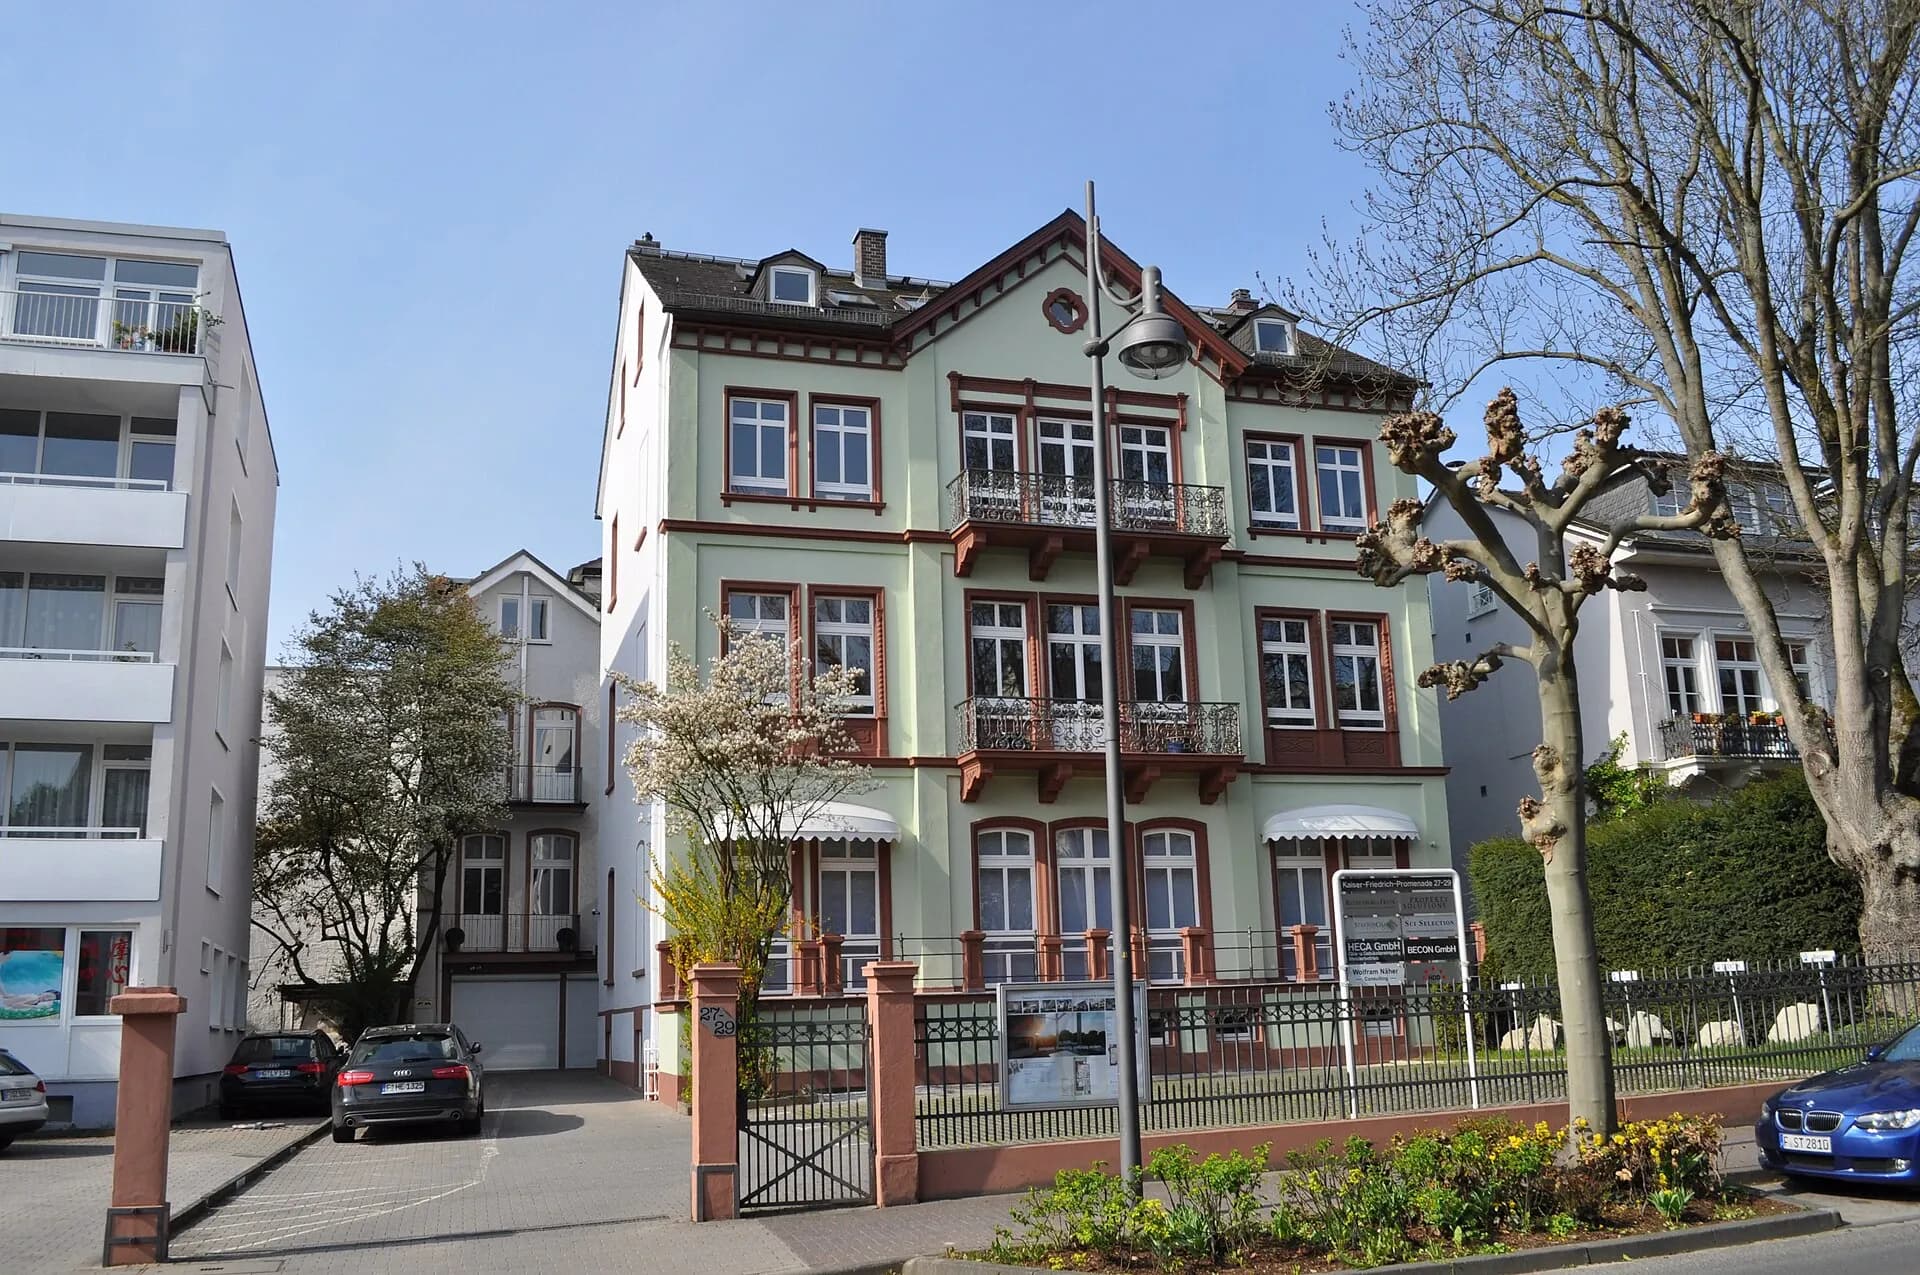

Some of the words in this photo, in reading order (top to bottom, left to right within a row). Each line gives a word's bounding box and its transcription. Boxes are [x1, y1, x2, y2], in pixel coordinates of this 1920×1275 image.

[1343, 880, 1433, 888] Kaiser-Friedrich-Promenade
[1434, 879, 1452, 887] 27-29
[1347, 942, 1372, 952] HECA
[1374, 941, 1400, 951] GmbH
[1407, 945, 1433, 954] BECON
[1435, 945, 1457, 953] GmbH
[1352, 968, 1379, 976] Wolfram
[1380, 967, 1398, 975] Näher
[701, 1008, 724, 1021] 27-
[714, 1021, 735, 1034] 29
[1793, 1137, 1803, 1148] ST
